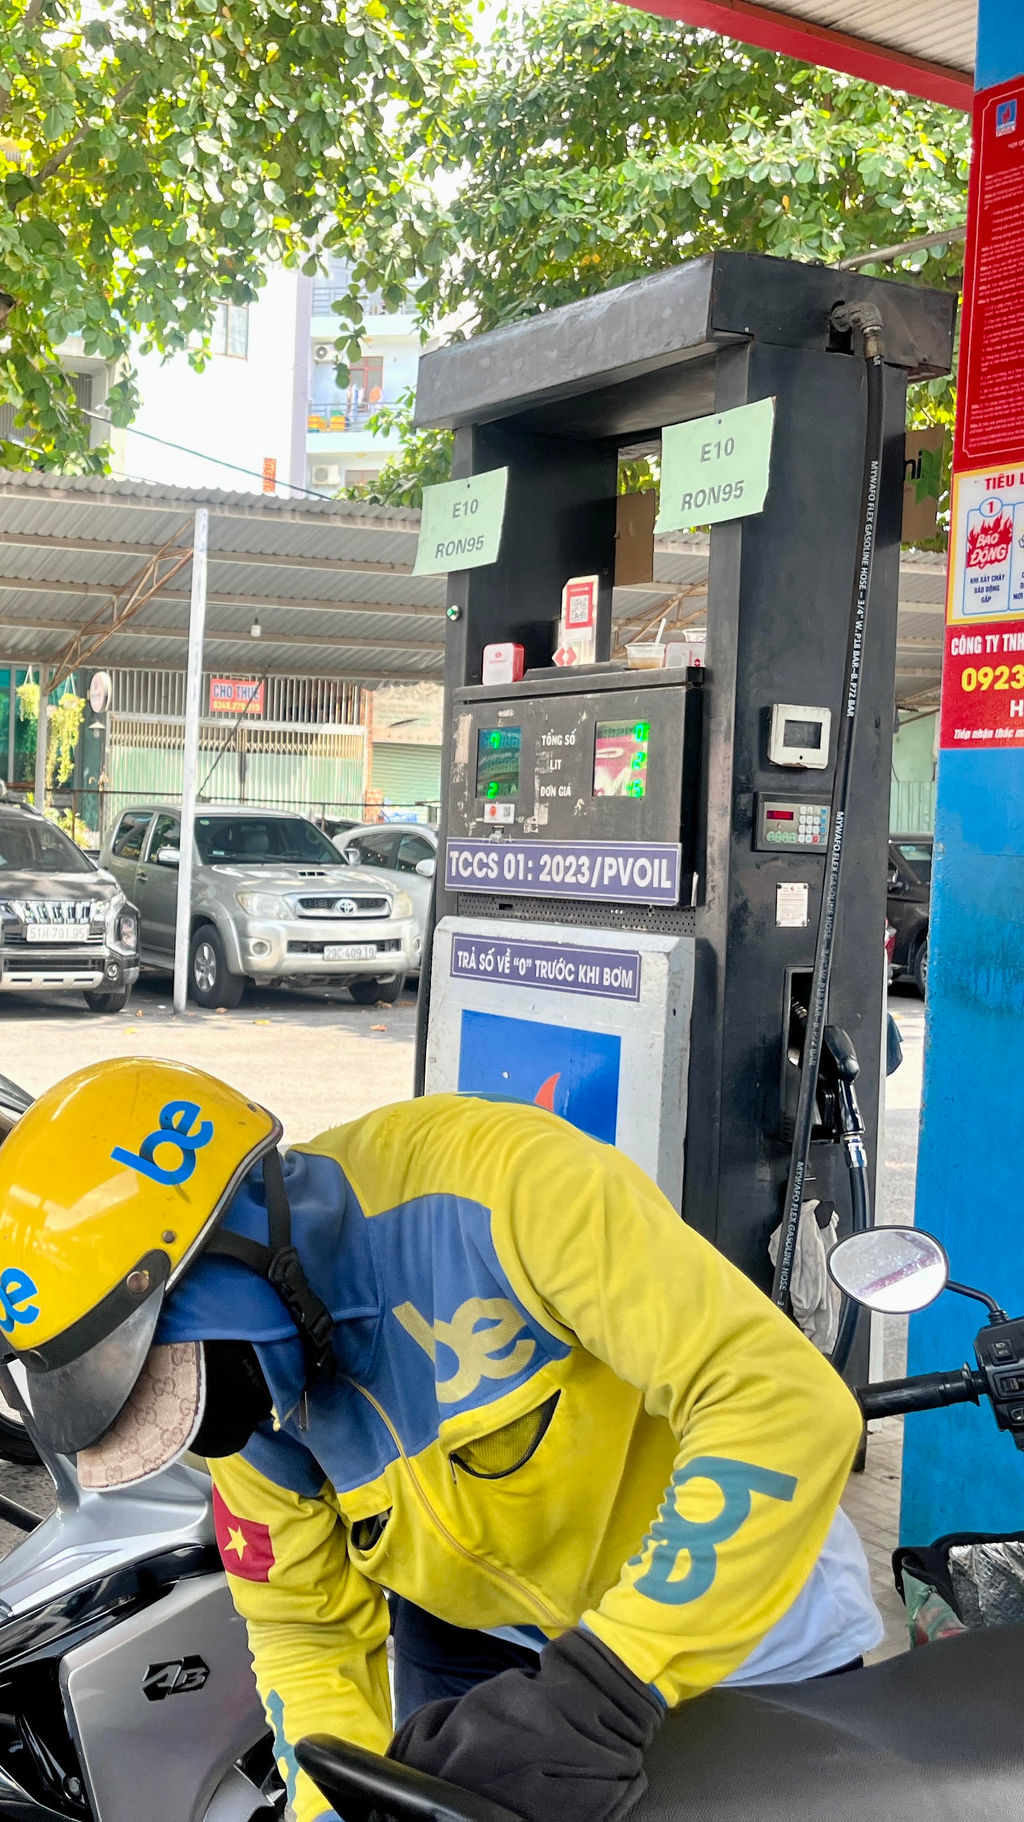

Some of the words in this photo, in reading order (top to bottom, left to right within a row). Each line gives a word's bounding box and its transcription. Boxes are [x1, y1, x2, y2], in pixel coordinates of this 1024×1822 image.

[699, 437, 735, 463] E10
[868, 460, 879, 501] MYWAFO
[681, 480, 745, 512] RON95
[987, 501, 994, 514] 1
[452, 498, 479, 518] E10
[866, 502, 876, 522] FLEX
[435, 535, 485, 559] RON95
[861, 524, 874, 566] GASOLINE
[976, 530, 999, 548] BÁO
[969, 544, 1007, 568] ĐỘNG
[859, 567, 869, 590] HOSE
[951, 634, 983, 656] CÔNG
[985, 634, 1000, 653] TY
[961, 664, 1024, 692] 0923
[213, 684, 233, 698] CHO
[847, 700, 855, 717] BAR
[541, 728, 563, 746] TỔNG
[564, 728, 577, 746] SỐ
[558, 782, 572, 797] GIÁ
[449, 851, 499, 879] TCCS
[503, 853, 533, 881] 01:
[539, 854, 672, 889] 2023/PVOIL
[457, 947, 477, 969] TRẢ
[478, 948, 495, 971] SỐ
[496, 948, 510, 973] VỀ
[535, 957, 575, 981] TRƯỚC
[578, 964, 600, 985] KHI
[603, 966, 633, 988] BƠM
[110, 1100, 214, 1186] be
[789, 1203, 798, 1222] FLEX
[783, 1224, 796, 1266] GASOLINE
[779, 1268, 789, 1290] HOSE
[392, 1297, 536, 1403] be
